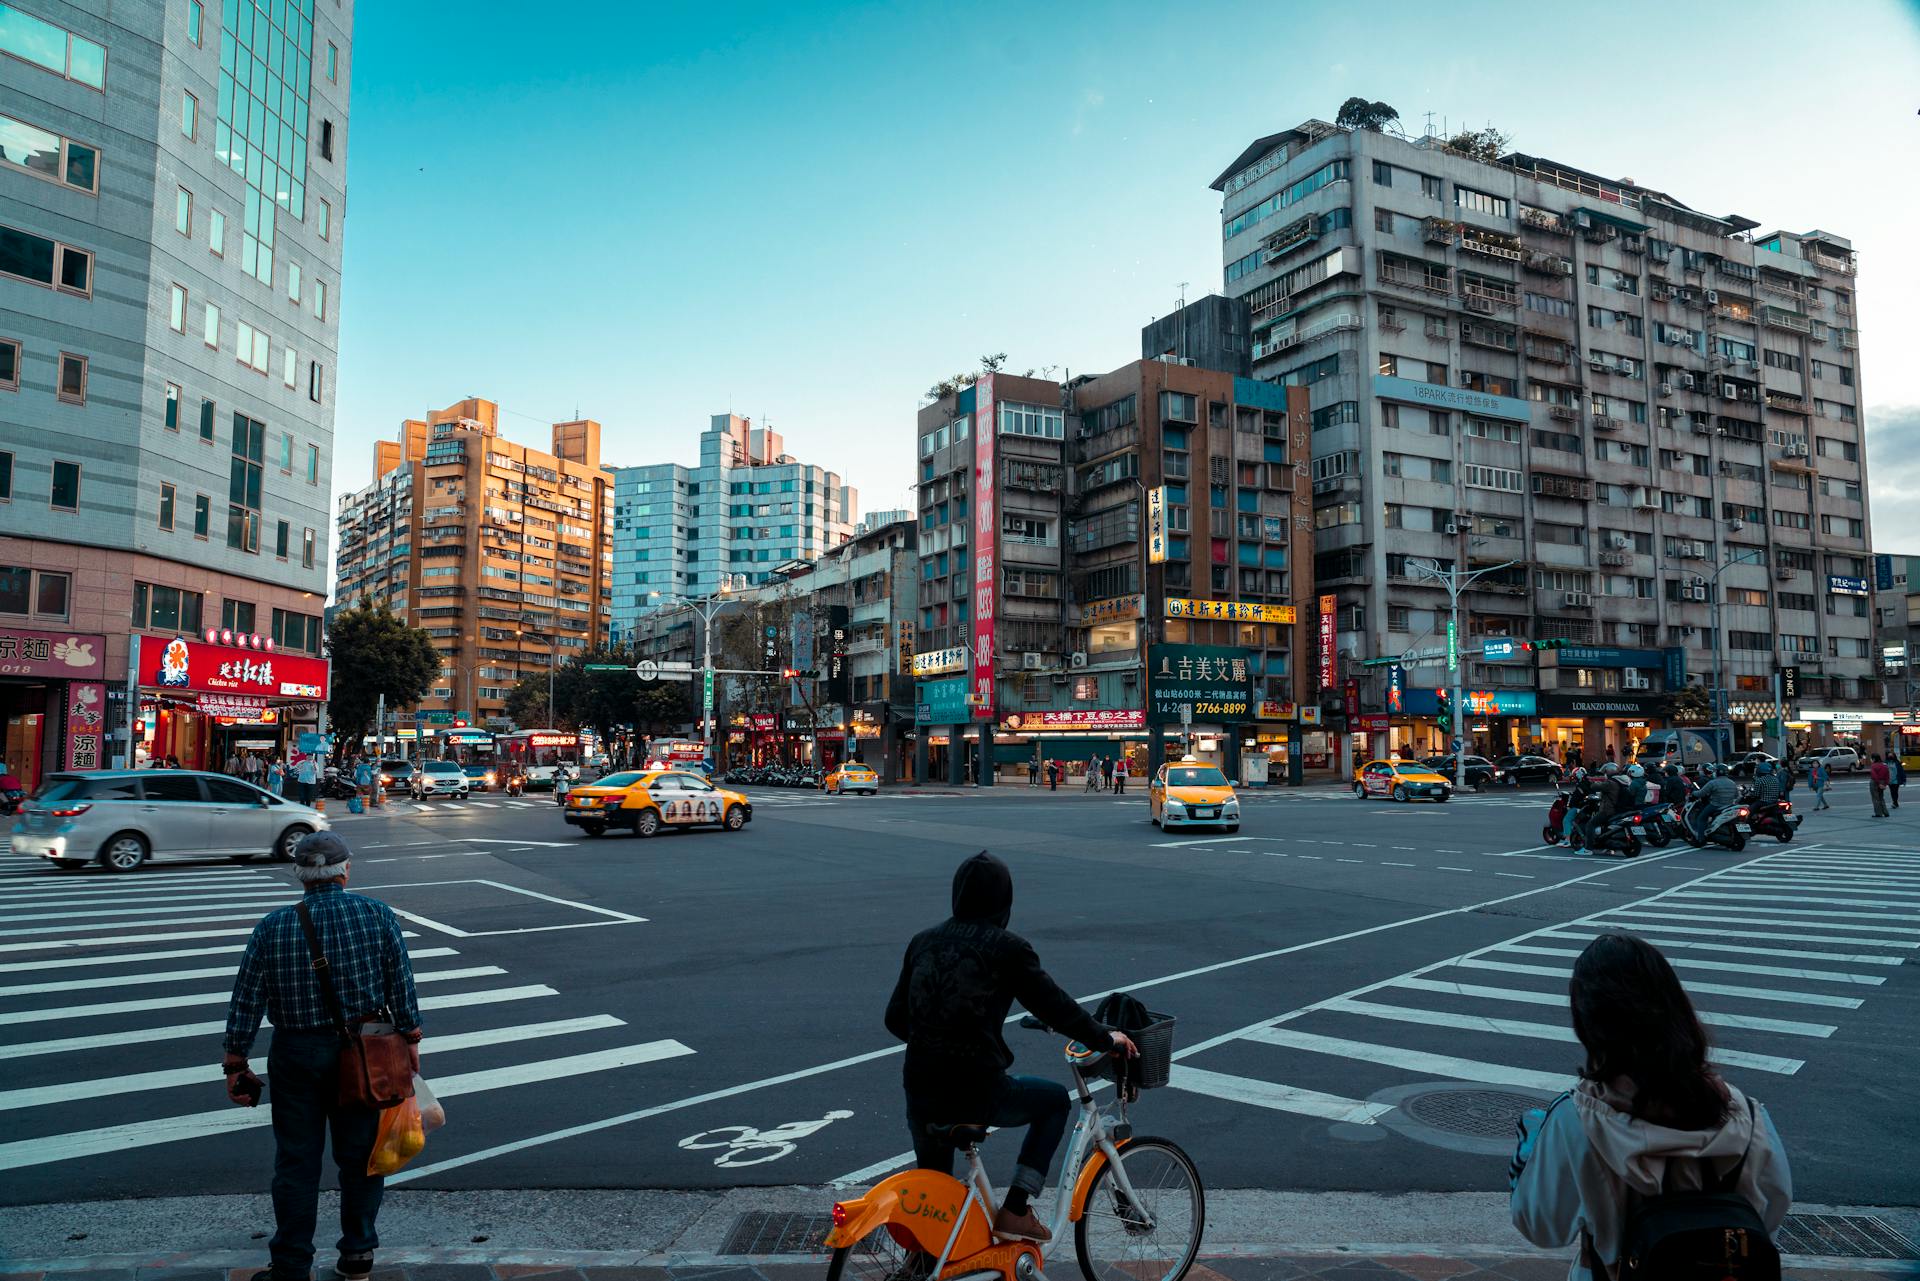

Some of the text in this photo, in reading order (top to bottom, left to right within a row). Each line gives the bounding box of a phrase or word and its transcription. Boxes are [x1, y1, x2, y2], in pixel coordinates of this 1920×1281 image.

[1414, 386, 1447, 401] 18PARK
[977, 587, 992, 620] 0933
[1178, 656, 1246, 682] 吉美艾麗
[1786, 669, 1793, 678] SO
[1195, 703, 1247, 714] 2766-8899
[1572, 702, 1640, 711] LORANZO ROMANZA
[73, 735, 97, 769] 涼麵
